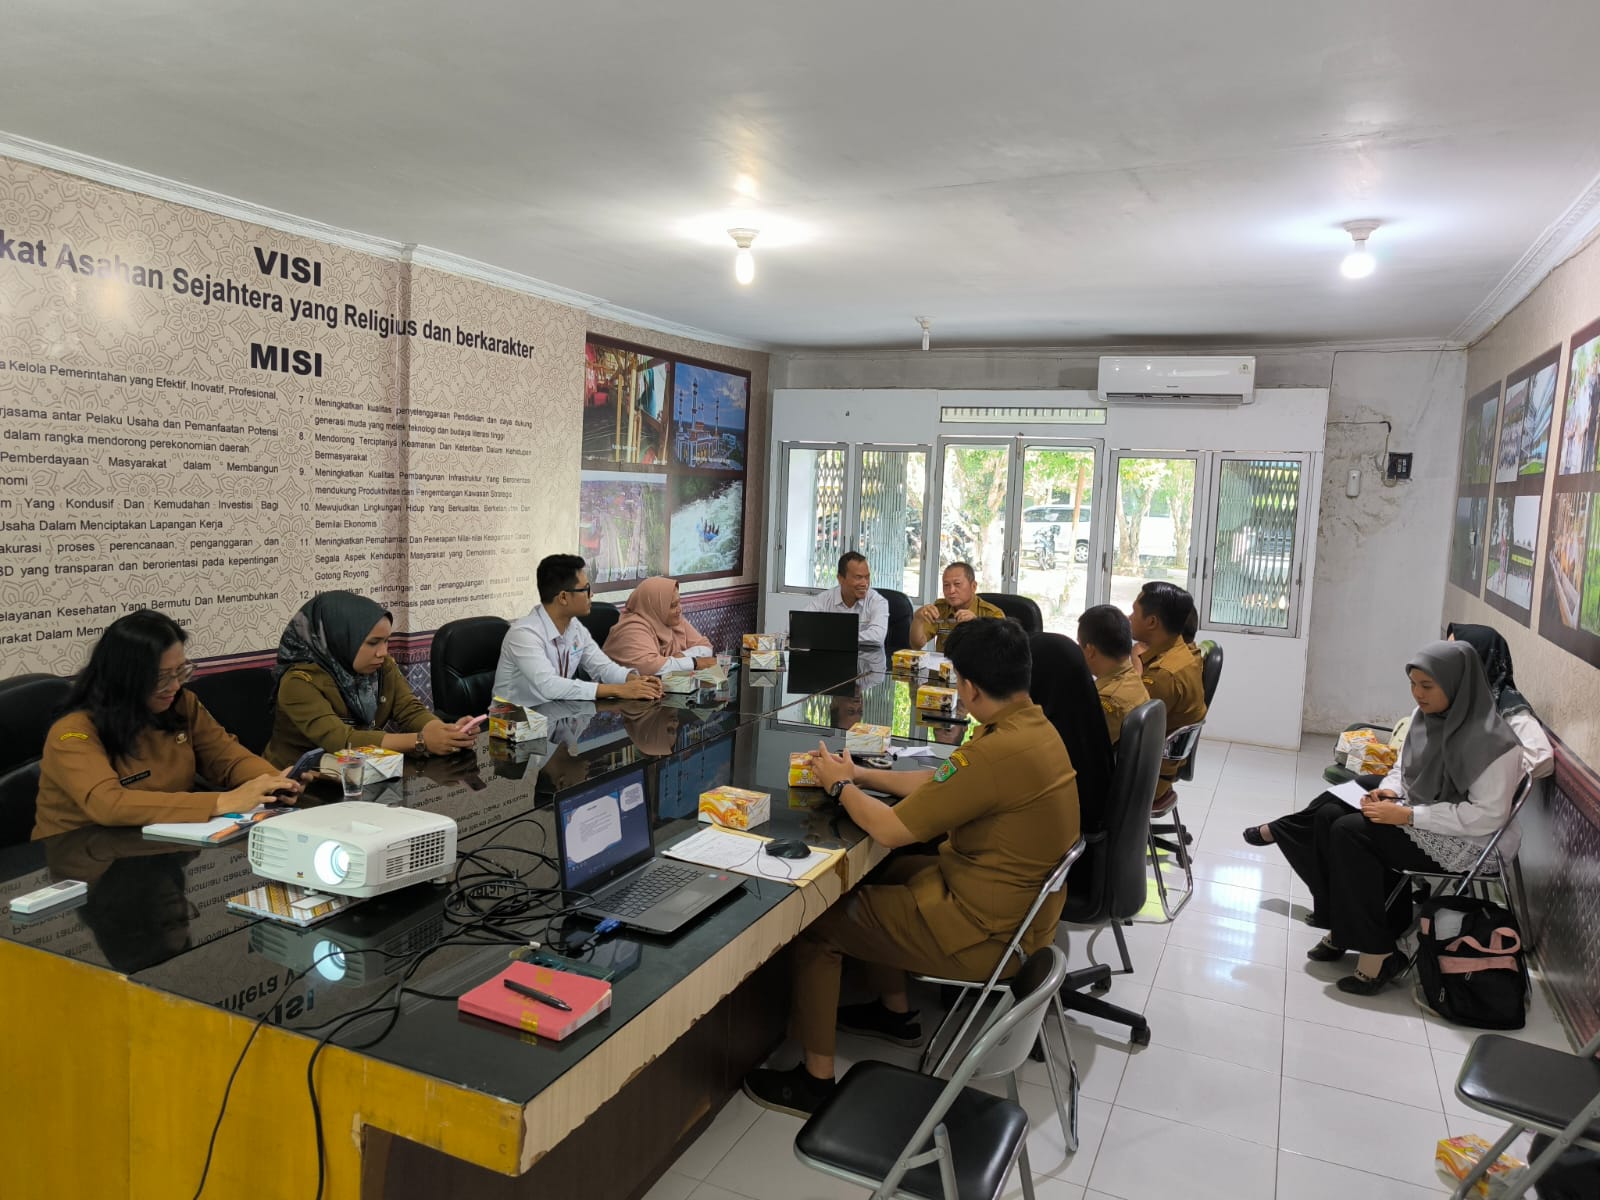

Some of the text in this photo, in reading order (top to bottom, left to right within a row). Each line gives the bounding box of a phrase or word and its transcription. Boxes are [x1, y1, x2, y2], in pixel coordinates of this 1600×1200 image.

[254, 247, 321, 287] VISI
[0, 229, 535, 359] kat Asahan Sejahtera yang Religius dan berkarakter
[251, 342, 322, 377] MISI
[10, 360, 47, 374] Kelola
[50, 365, 126, 383] Pemerintahan
[130, 376, 154, 388] yang
[315, 398, 363, 410] Meningkatkan
[52, 411, 81, 421] antar
[86, 413, 122, 425] Pelaku
[127, 416, 159, 427] Usaha
[163, 419, 181, 429] dan
[184, 420, 244, 434] Pemanfaatan
[248, 426, 279, 436] Potensi
[315, 416, 345, 426] generasi
[347, 420, 366, 428] muda
[368, 421, 384, 431] yang
[4, 429, 250, 453] dalam rangka mendorong perekonomian daerah
[315, 433, 355, 445] Mendorong
[359, 437, 397, 448] Terciptanya
[401, 440, 435, 449] Keamanan
[440, 442, 451, 450] Dan
[0, 451, 279, 475] Pemberdayaan Masyarakat dalam Membangun
[315, 450, 367, 462] Bermasyarakat
[315, 468, 363, 479] Meningkatkan
[368, 470, 395, 479] Kualitas
[315, 486, 356, 497] mendukung
[24, 498, 55, 511] Yang
[66, 499, 115, 509] Kondusif
[124, 500, 145, 509] Dan
[154, 500, 210, 509] Kemudahan
[261, 501, 279, 512] Bagi
[315, 503, 359, 513] Mewujudkan
[363, 504, 401, 513] Lingkungan
[406, 504, 424, 513] Hidup
[429, 504, 444, 513] Yang
[40, 520, 76, 531] Dalam
[80, 520, 147, 532] Menciptakan
[150, 520, 196, 531] Lapangan
[200, 520, 223, 531] Kerja
[344, 520, 377, 528] Ekonomis
[0, 543, 42, 554] akurasi
[57, 543, 95, 554] proses
[190, 539, 253, 550] penganggaran
[264, 537, 279, 546] dan
[315, 537, 363, 547] Meningkatkan
[315, 555, 339, 564] Segala
[344, 553, 366, 563] Aspek
[370, 552, 405, 561] Kehidupan
[410, 551, 445, 560] Masyarakat
[449, 550, 463, 559] yang
[20, 566, 49, 578] yang
[55, 563, 114, 575] transparan
[119, 561, 138, 571] dan
[143, 559, 198, 570] berorientasi
[202, 558, 224, 569] pada
[229, 556, 279, 567] kepentingan
[315, 570, 369, 581] Gotong Royong
[0, 609, 52, 624] elayanan
[57, 603, 116, 617] Kesehatan
[151, 599, 191, 609] Bermutu
[195, 596, 213, 606] Dan
[217, 592, 279, 604] Menumbuhkan
[36, 629, 73, 641] Dalam
